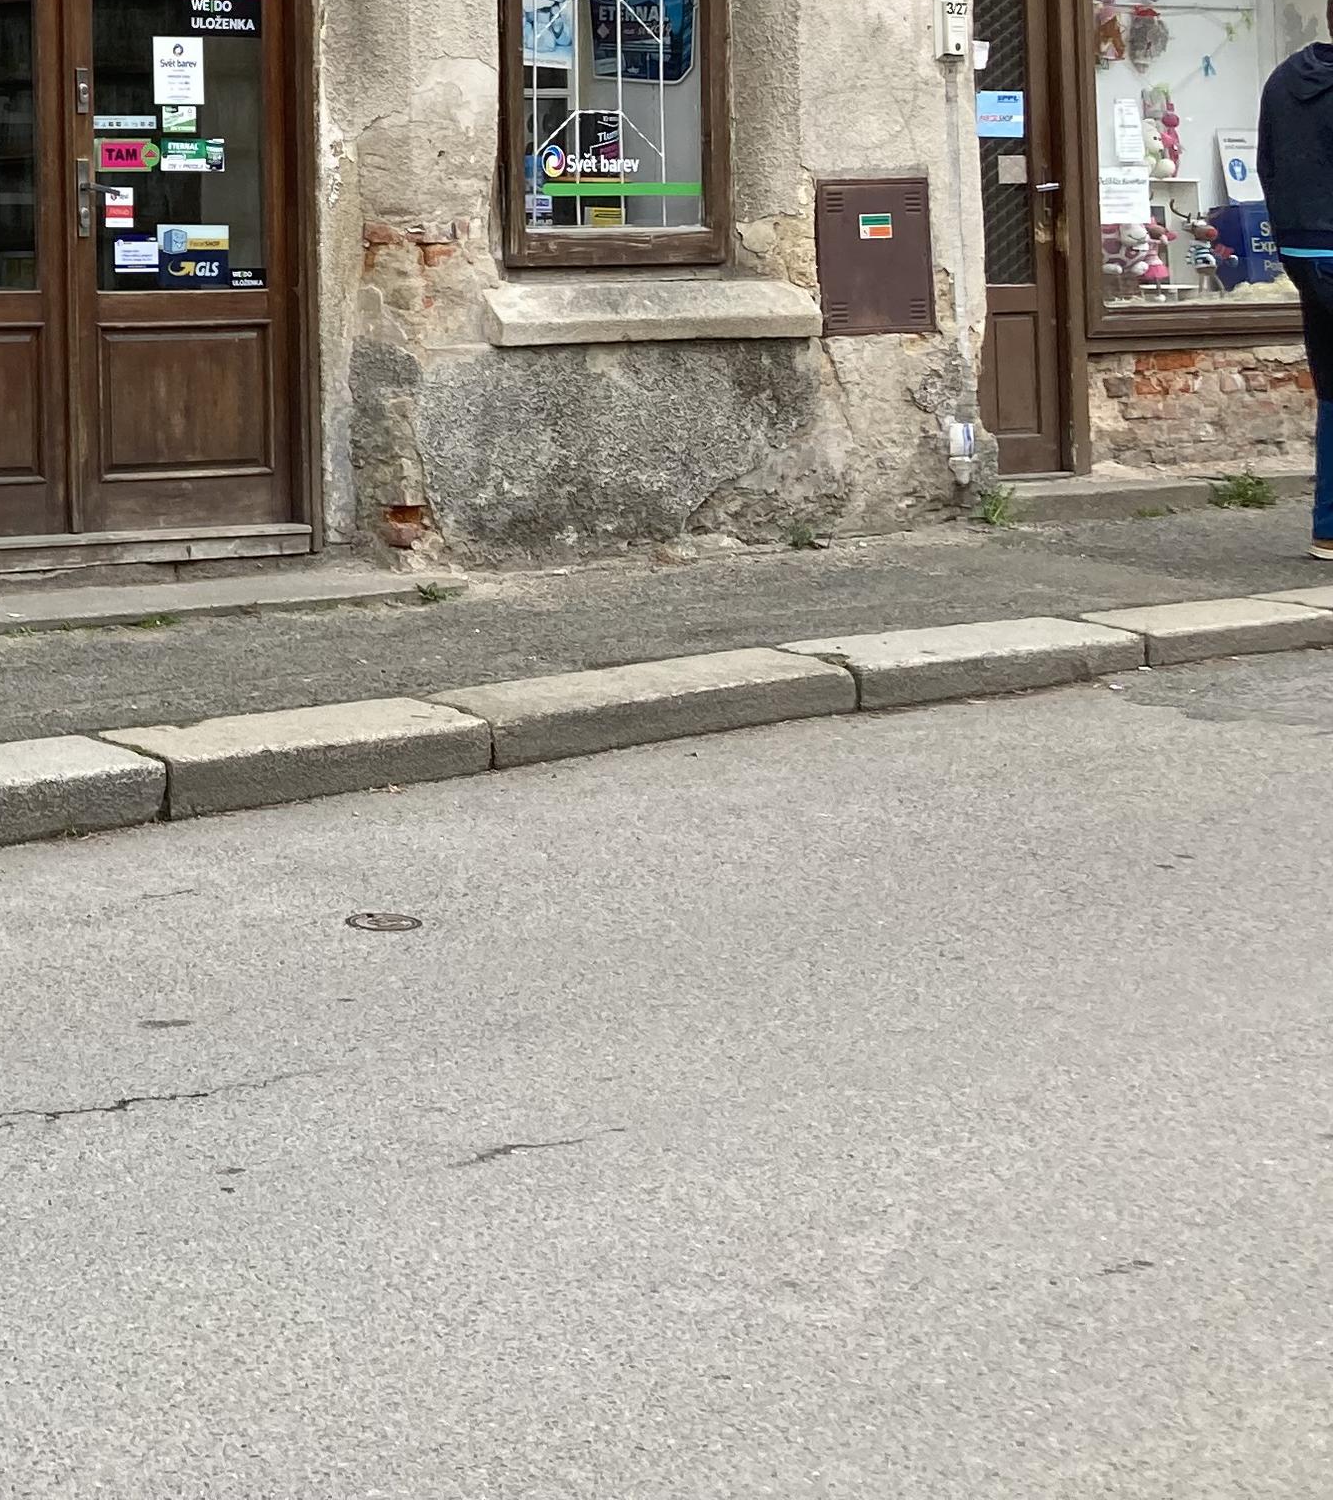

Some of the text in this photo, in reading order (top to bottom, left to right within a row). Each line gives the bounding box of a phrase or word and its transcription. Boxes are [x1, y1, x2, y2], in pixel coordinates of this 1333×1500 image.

[946, 1, 968, 16] 3/27
[190, 14, 256, 31] ULOŽENKA
[159, 58, 197, 68] Svět barev
[104, 148, 138, 161] TAM
[566, 152, 597, 173] Svět
[600, 154, 639, 173] barev
[195, 261, 220, 277] GLS
